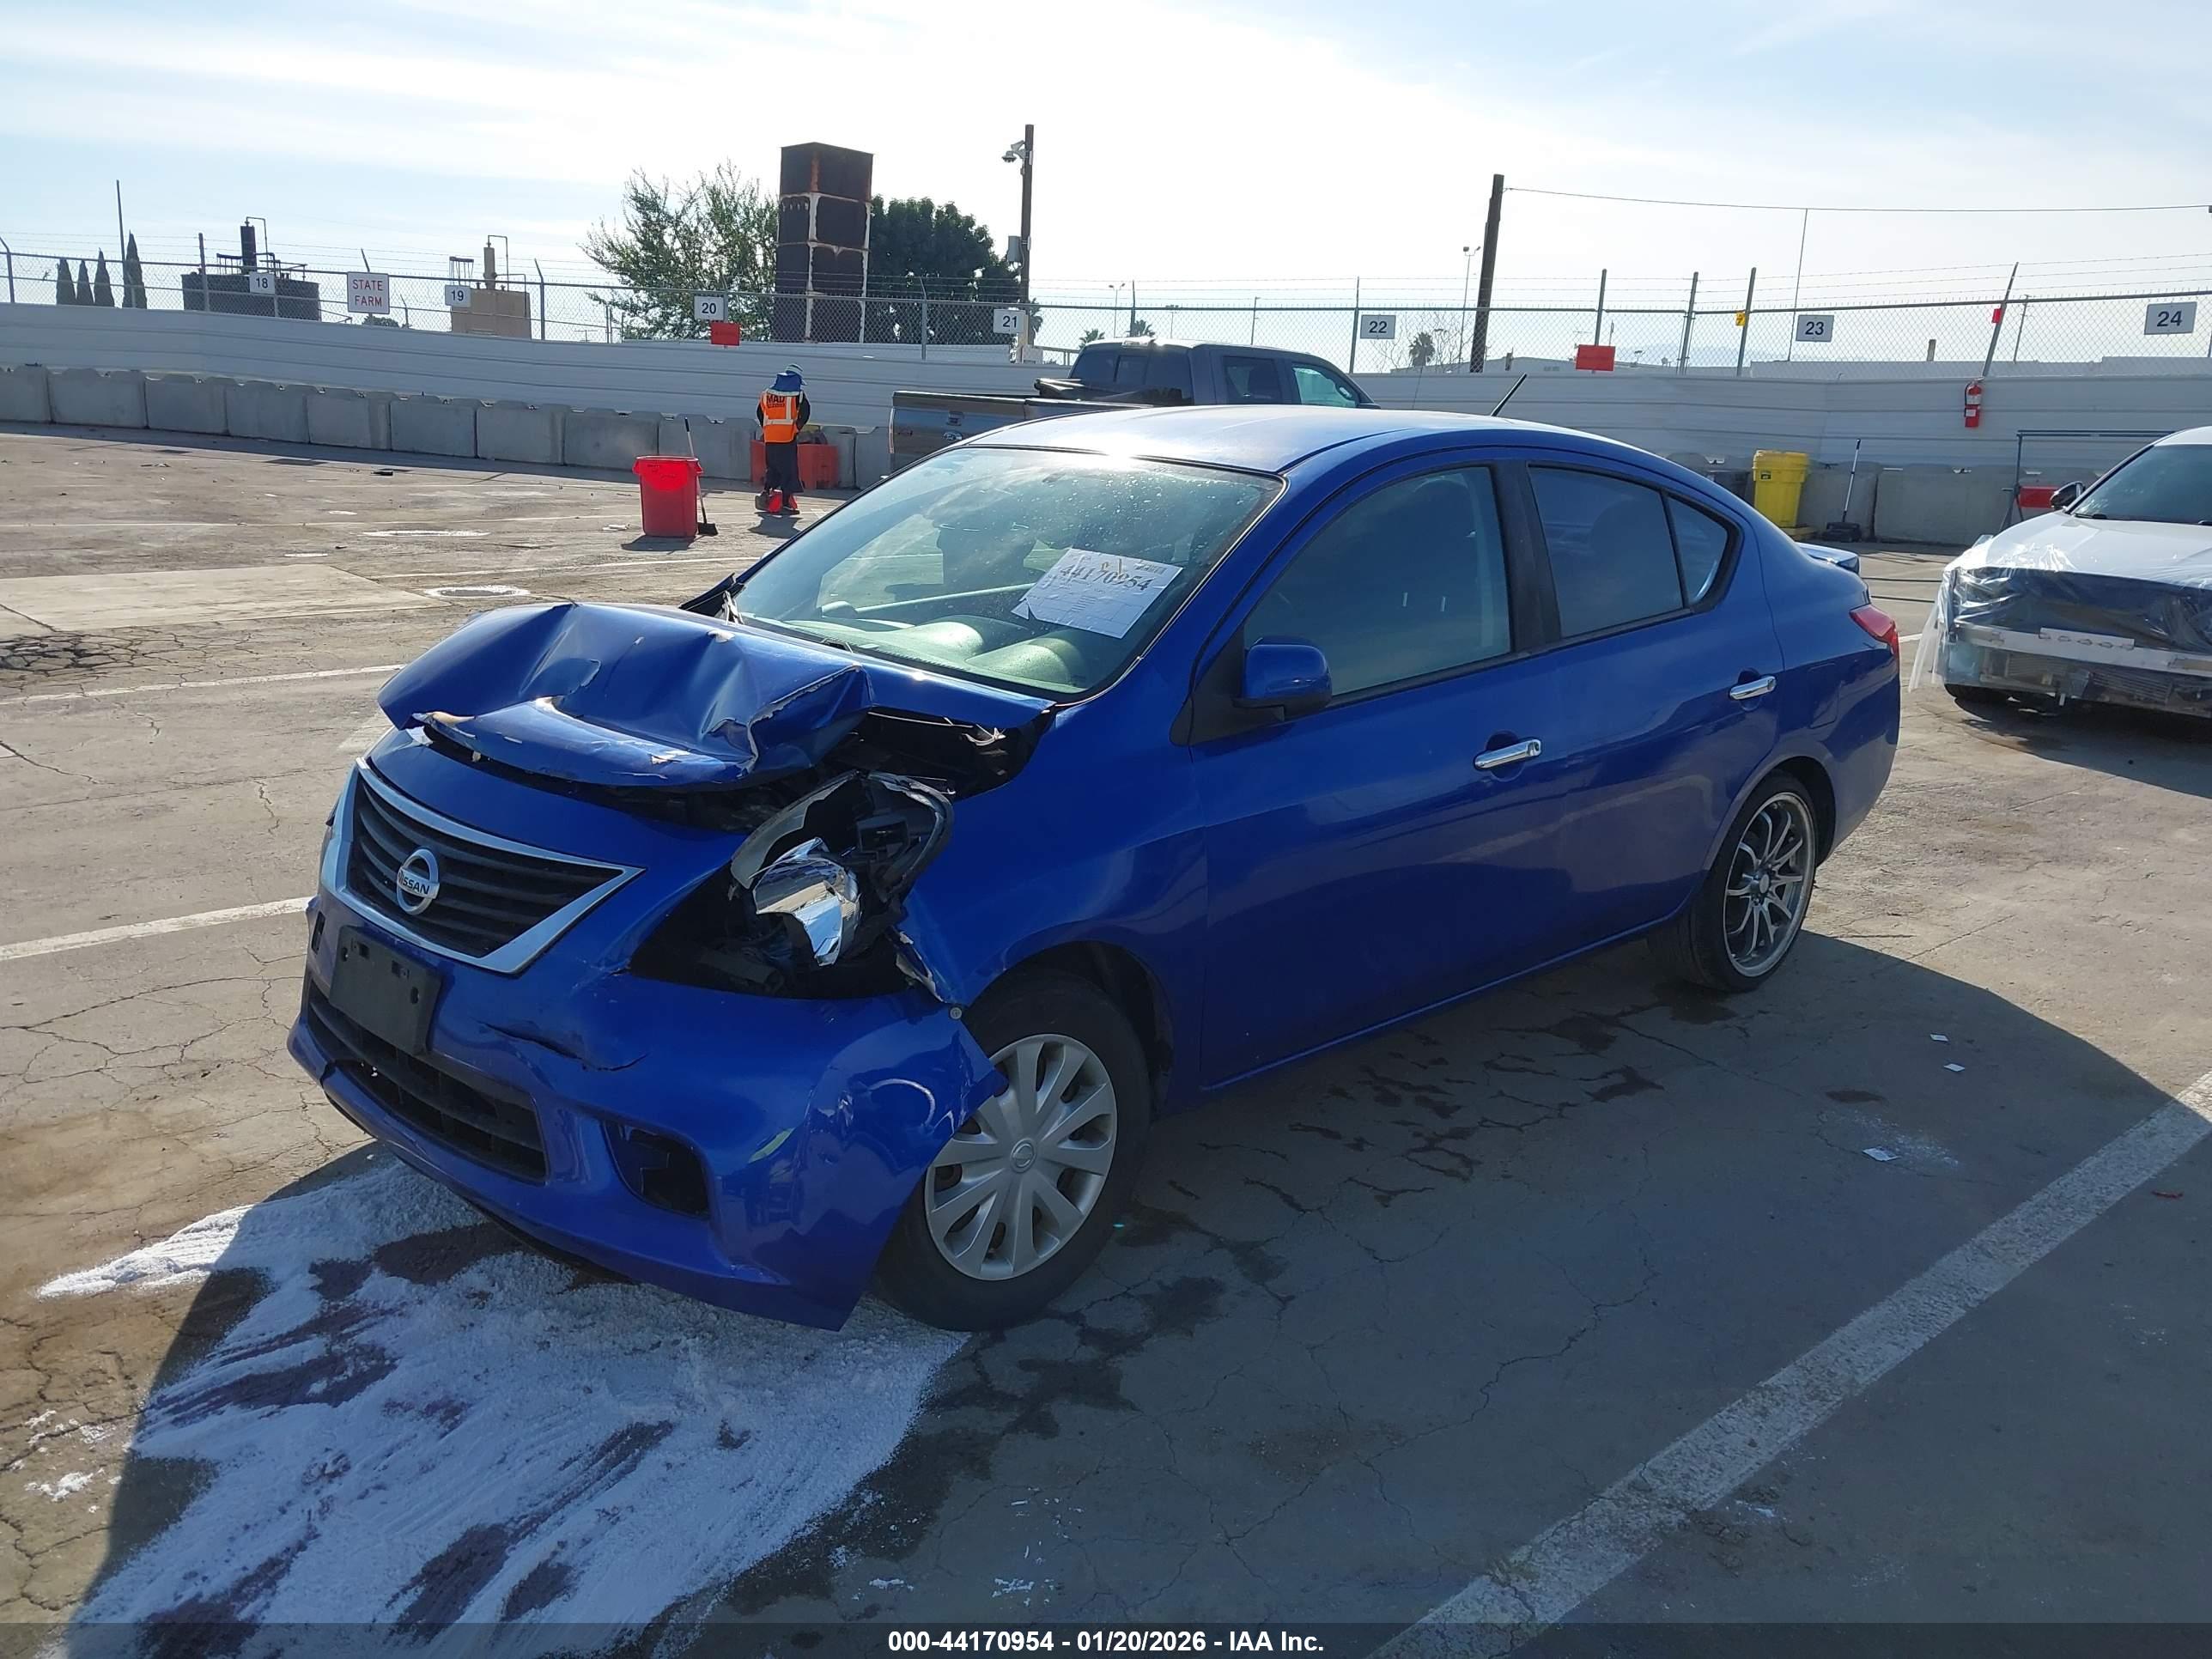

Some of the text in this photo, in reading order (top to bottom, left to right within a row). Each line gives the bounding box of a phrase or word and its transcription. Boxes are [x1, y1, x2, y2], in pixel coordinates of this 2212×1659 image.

[256, 277, 268, 289] 18
[352, 279, 384, 291] STATE
[355, 295, 383, 307] FARM
[451, 289, 464, 301] 19
[702, 302, 717, 314] 20
[1002, 315, 1018, 328] 21
[2156, 310, 2183, 327] 24
[1369, 320, 1388, 333] 22
[1805, 321, 1825, 336] 23
[1060, 566, 1153, 591] 44170954
[398, 869, 430, 895] NISSAN
